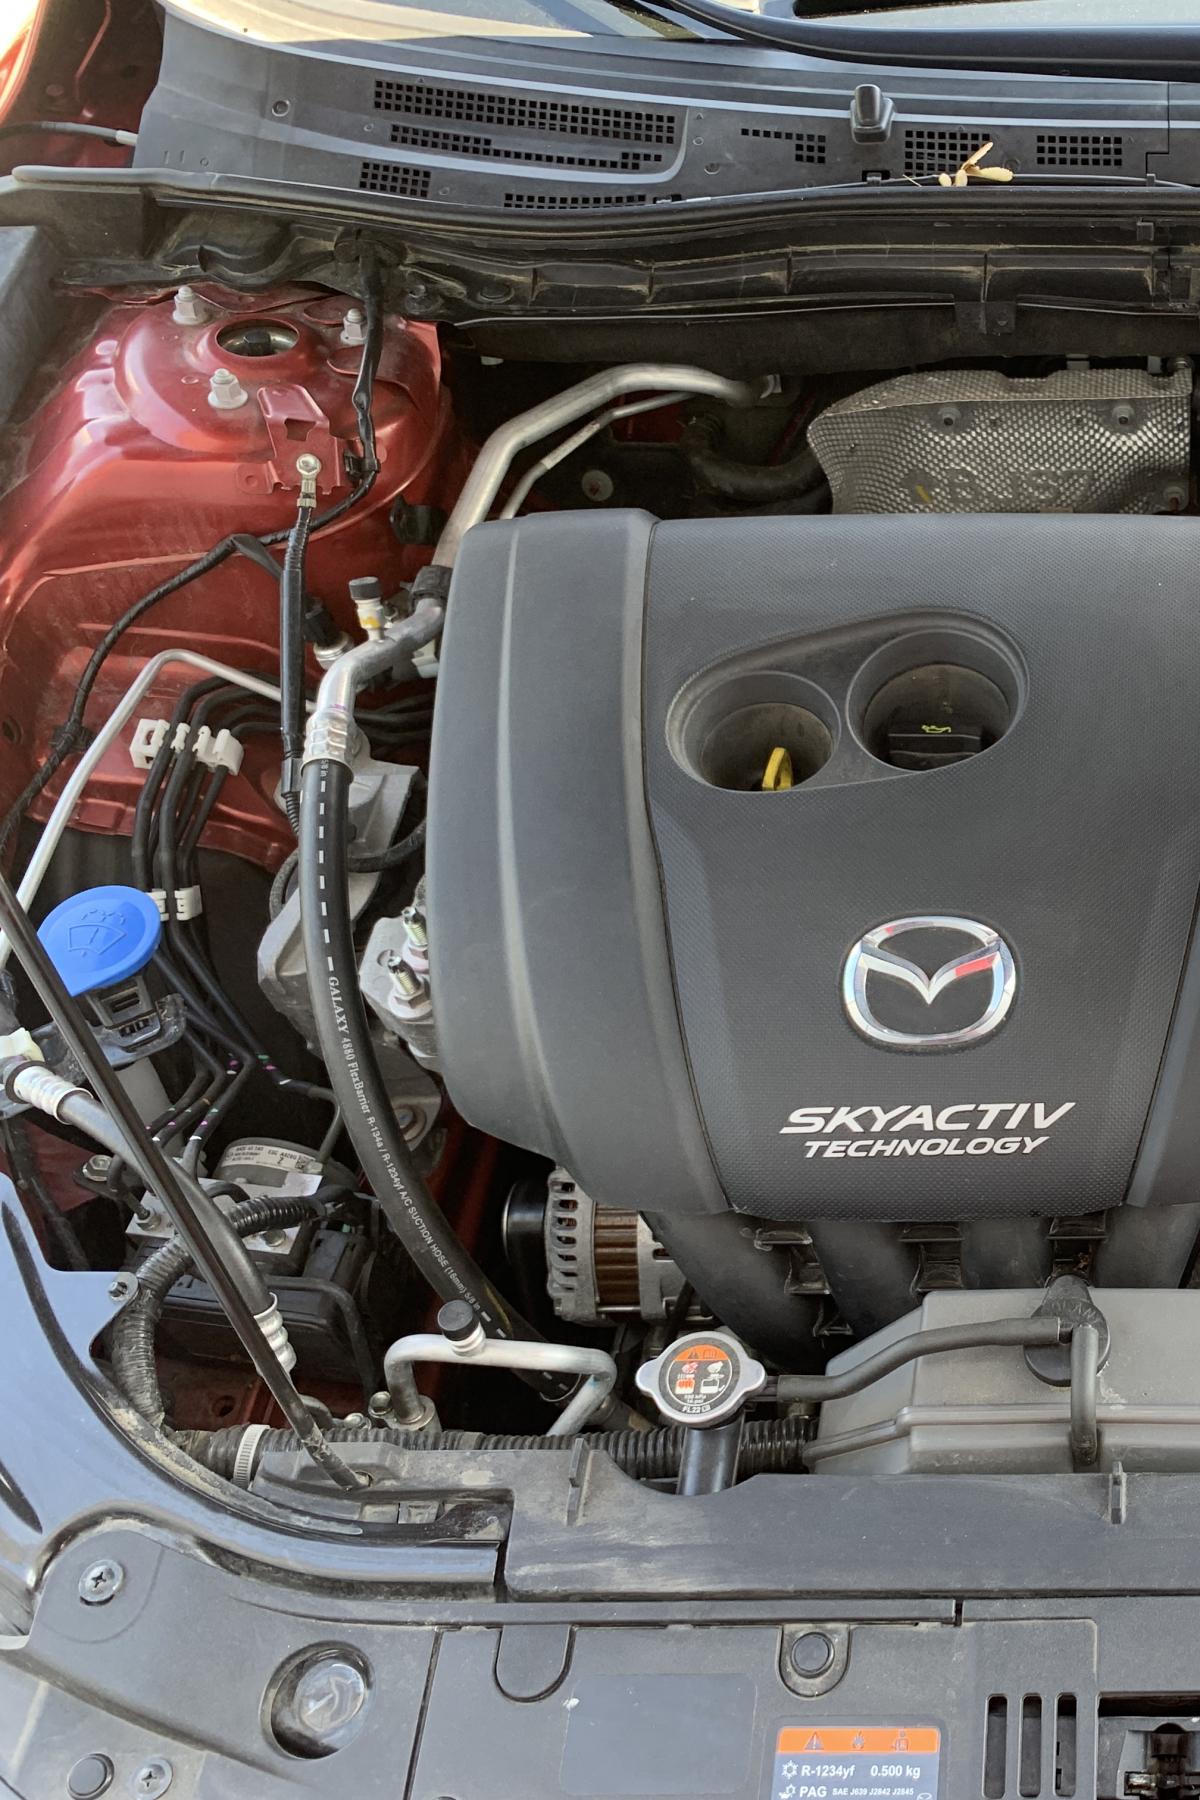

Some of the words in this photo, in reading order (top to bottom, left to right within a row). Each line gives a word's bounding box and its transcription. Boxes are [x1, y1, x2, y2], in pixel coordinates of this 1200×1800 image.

[328, 976, 350, 1034] GALAXY
[341, 1037, 356, 1061] 4880
[347, 1061, 371, 1114] FlexBarrier
[366, 1116, 384, 1148] R-134a
[779, 1102, 1076, 1135] SKYACTIV
[804, 1136, 1051, 1159] TECHNOLOGY
[382, 1153, 405, 1191] R-1234yf
[399, 1191, 413, 1206] A/C
[408, 1206, 434, 1244] SUCTION
[430, 1243, 449, 1267] HOSE
[444, 1267, 467, 1294] (16mm)
[801, 1764, 856, 1779] R-1234yf
[870, 1765, 902, 1777] 0.500
[905, 1765, 921, 1779] kg
[799, 1786, 827, 1798] PAG
[832, 1788, 849, 1796] SAE
[850, 1788, 868, 1796] J639
